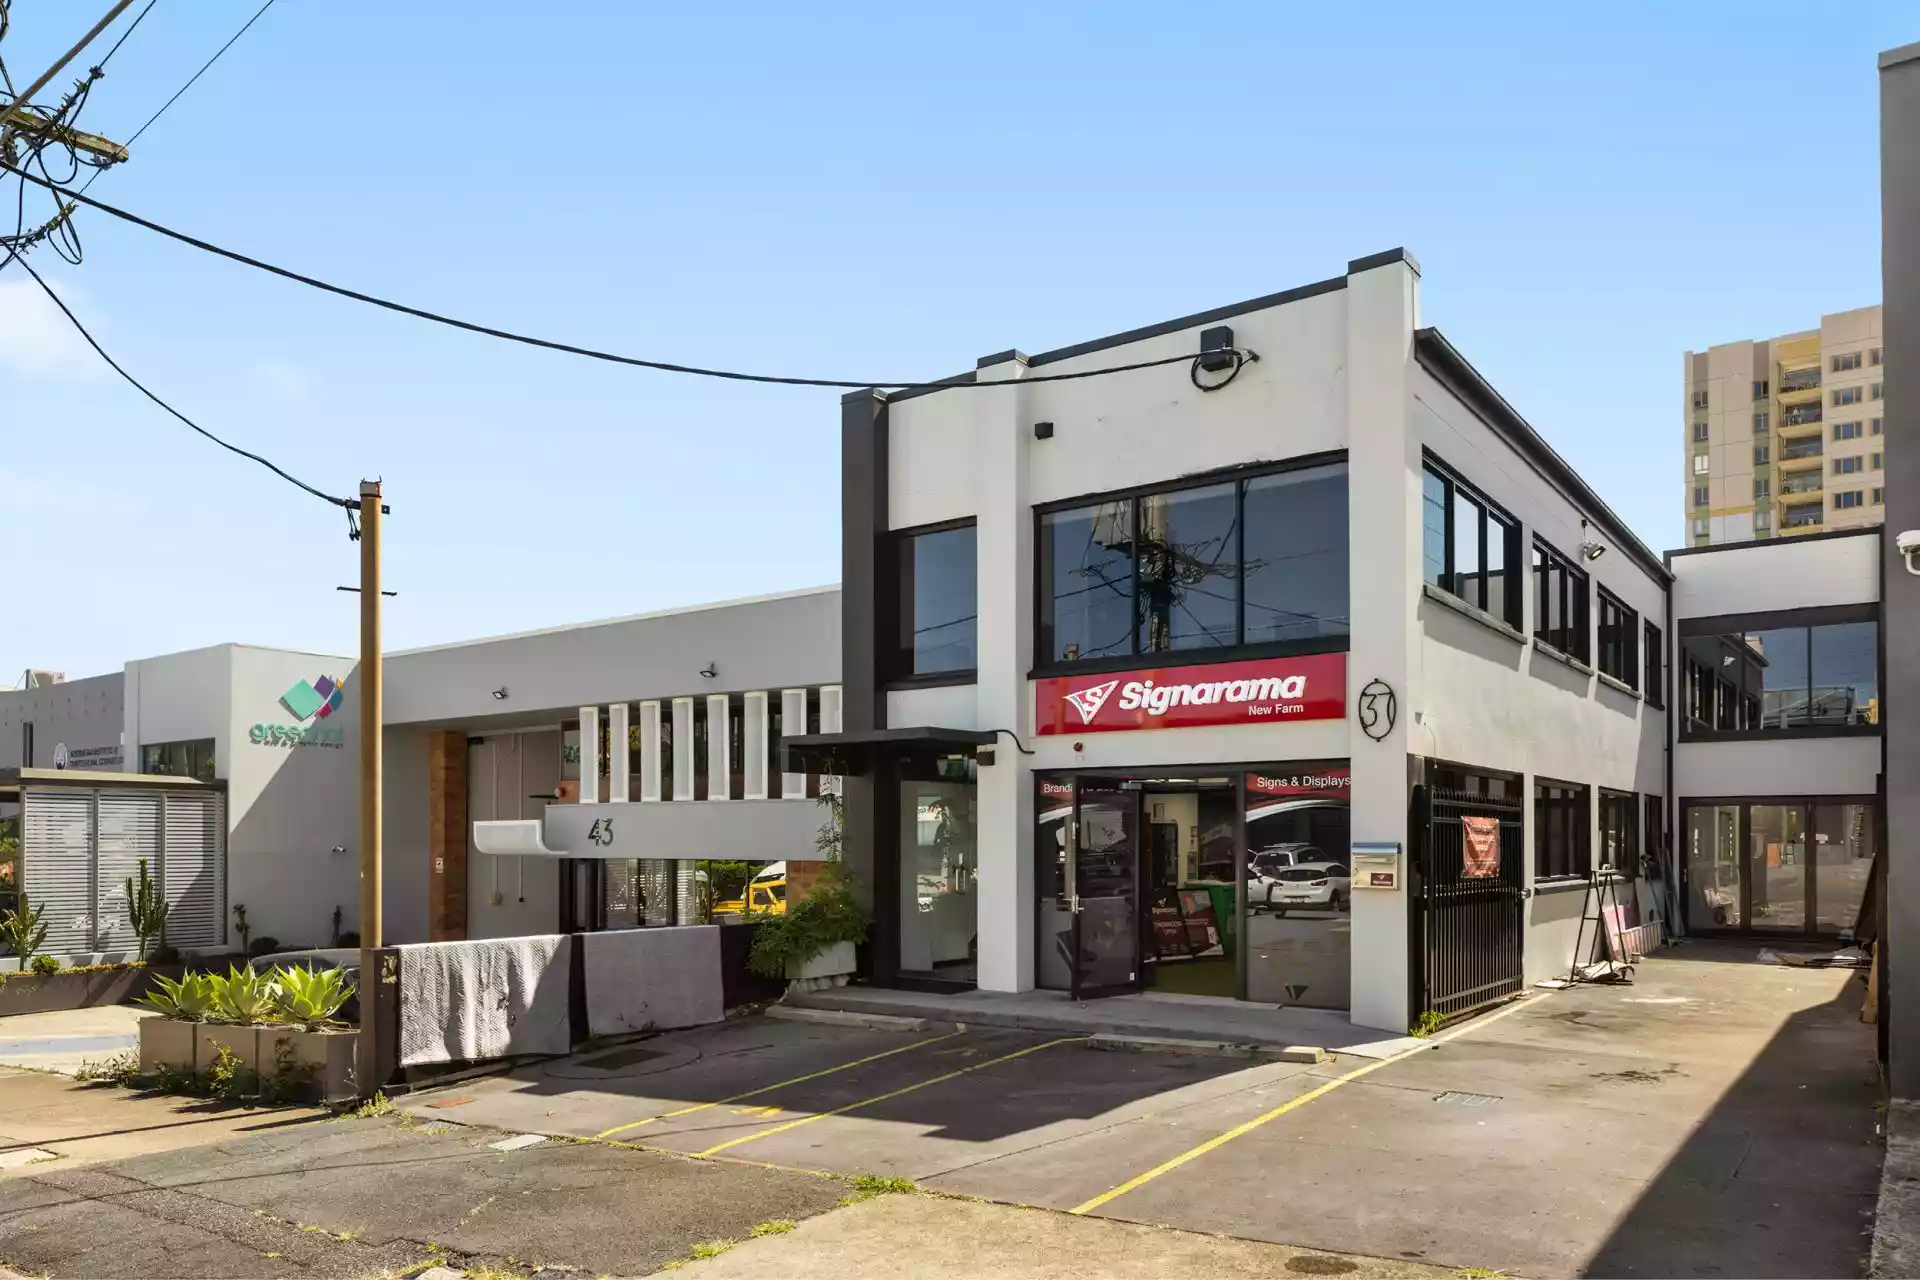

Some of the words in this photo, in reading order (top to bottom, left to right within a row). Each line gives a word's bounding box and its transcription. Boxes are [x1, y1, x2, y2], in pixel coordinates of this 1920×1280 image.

[1119, 676, 1307, 716] Signarama
[1248, 704, 1272, 716] New
[1275, 703, 1304, 714] Farm
[1257, 776, 1288, 789] Signs
[1290, 776, 1300, 787] &
[1303, 775, 1352, 788] Displays
[587, 818, 614, 846] 43
